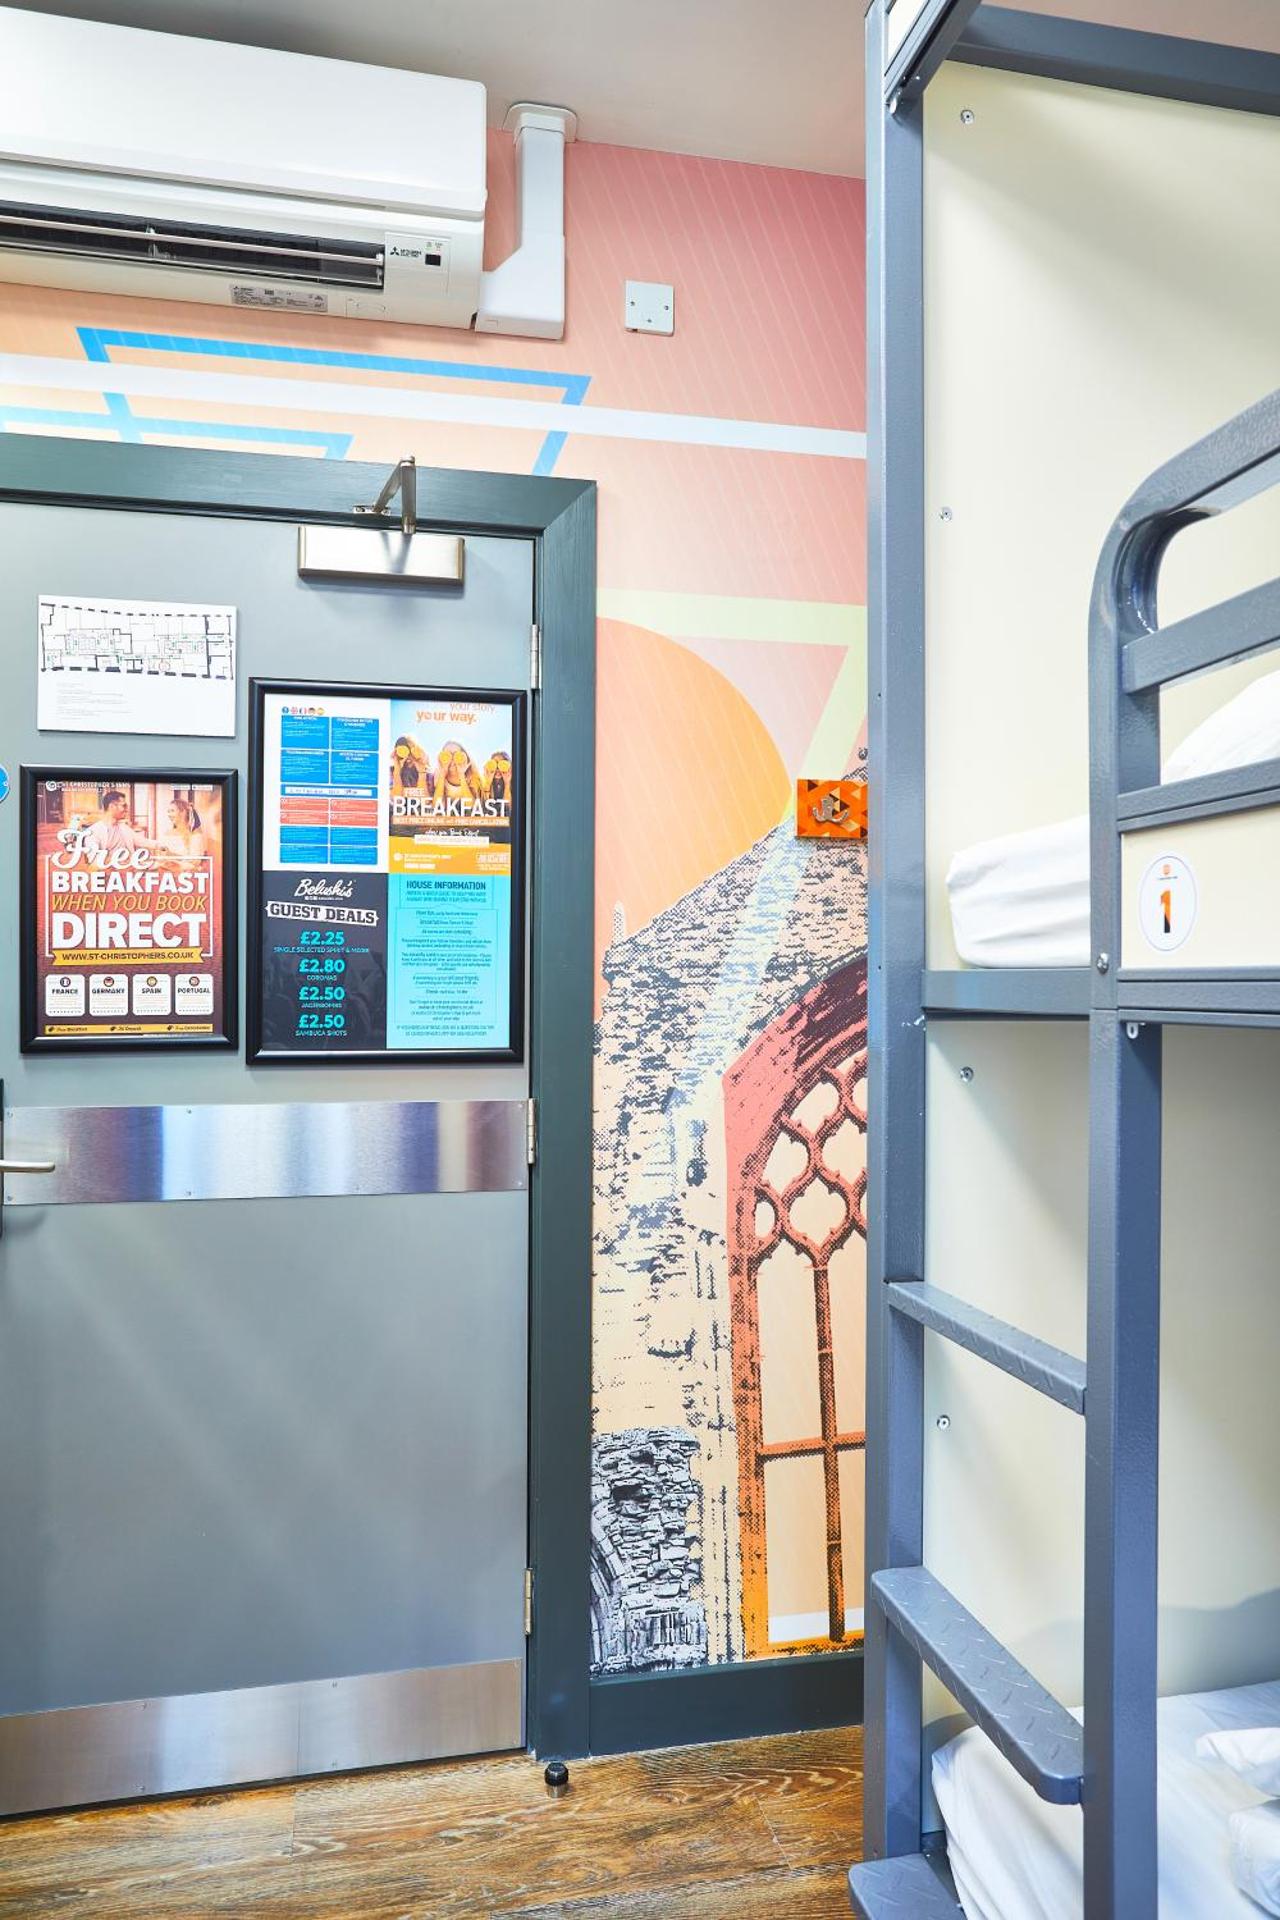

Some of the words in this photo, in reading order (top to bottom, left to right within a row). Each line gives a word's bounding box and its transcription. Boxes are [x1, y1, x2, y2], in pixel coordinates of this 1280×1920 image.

[393, 796, 509, 817] BREAKFAST
[51, 828, 154, 870] Free
[52, 871, 209, 893] BREAKFAST
[294, 878, 353, 898] Belushi's
[406, 880, 432, 889] HOUSE
[434, 881, 487, 890] INFORMATION
[52, 894, 106, 912] WHEN
[112, 894, 149, 912] YOU
[155, 895, 208, 912] BOOK
[1160, 889, 1171, 934] 1
[269, 902, 321, 919] GUEST
[325, 908, 375, 924] DEALS
[52, 912, 207, 949] DIRECT
[300, 931, 345, 945] £2.25
[62, 951, 194, 962] WWW.ST-CHRISTOPHERS.CO.UK
[299, 958, 346, 973] £2.80
[299, 986, 345, 1001] £2.50
[299, 1014, 345, 1029] £2.50
